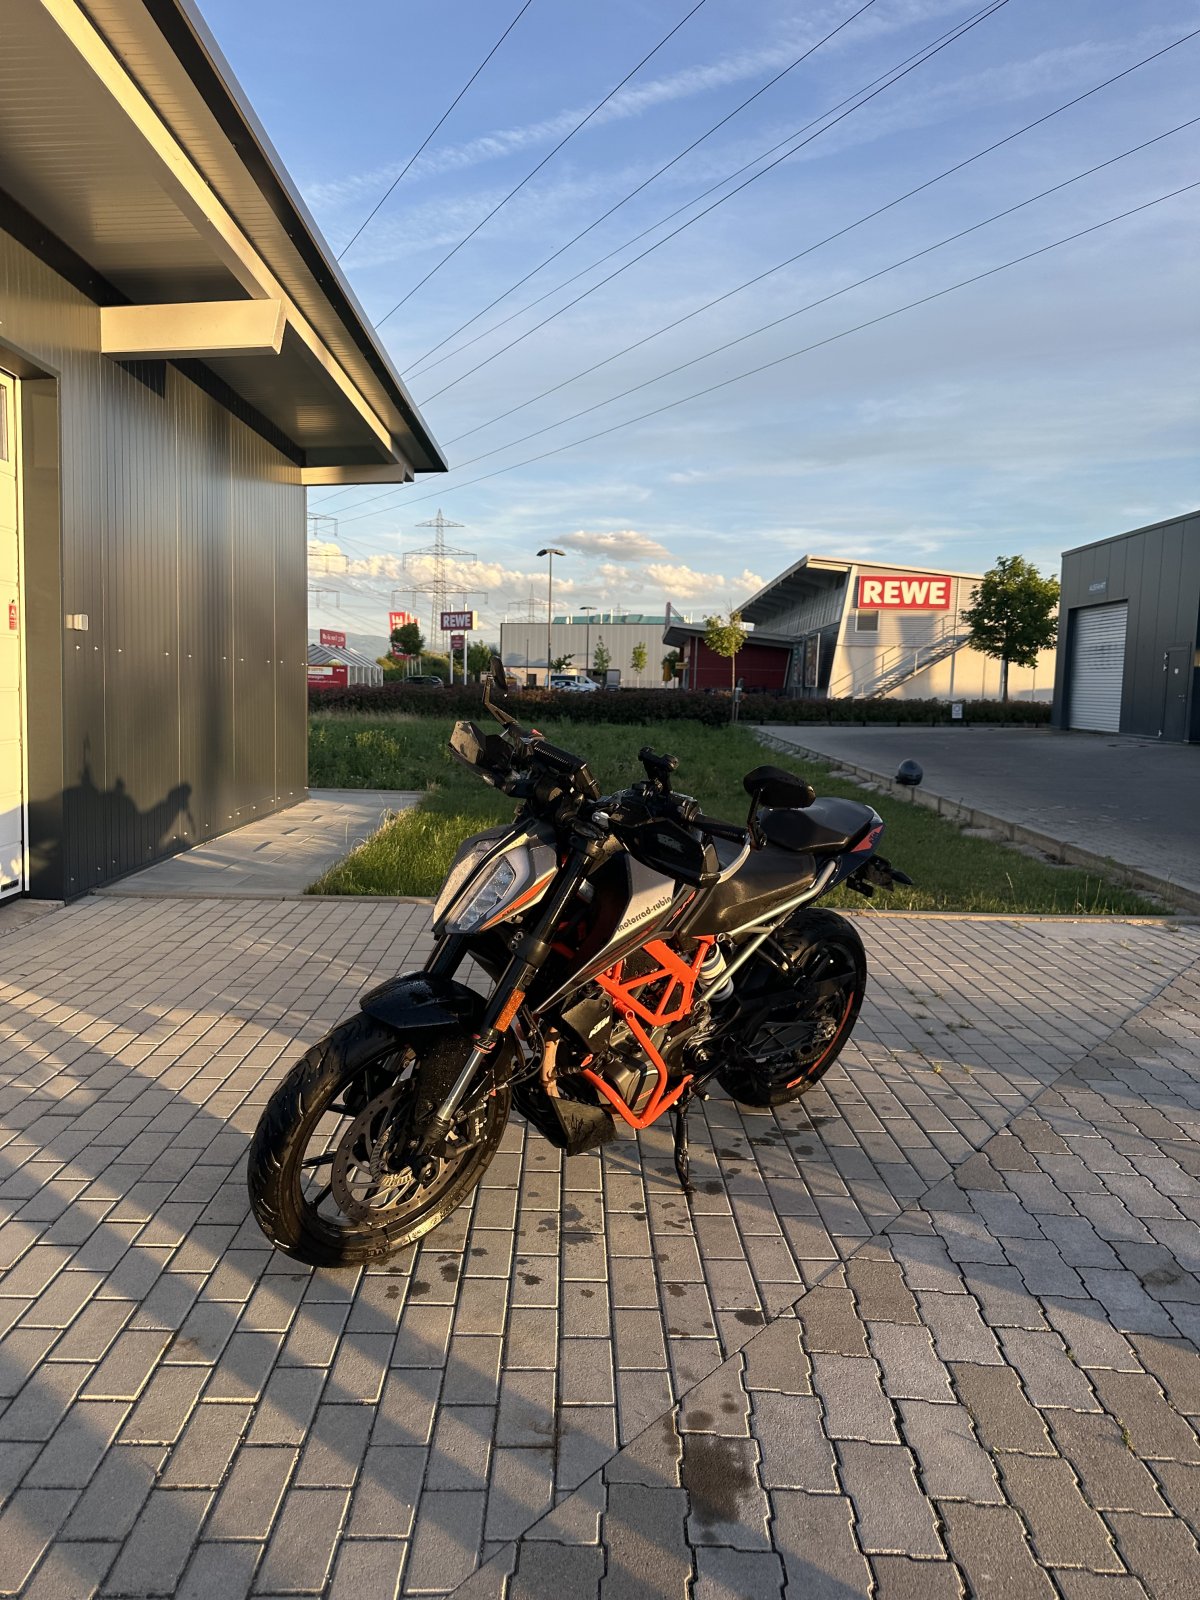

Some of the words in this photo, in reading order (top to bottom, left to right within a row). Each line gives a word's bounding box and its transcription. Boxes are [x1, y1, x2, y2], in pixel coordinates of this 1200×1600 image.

[863, 580, 947, 606] REWE
[442, 613, 471, 628] REWE
[616, 896, 673, 933] motorrad-rubin
